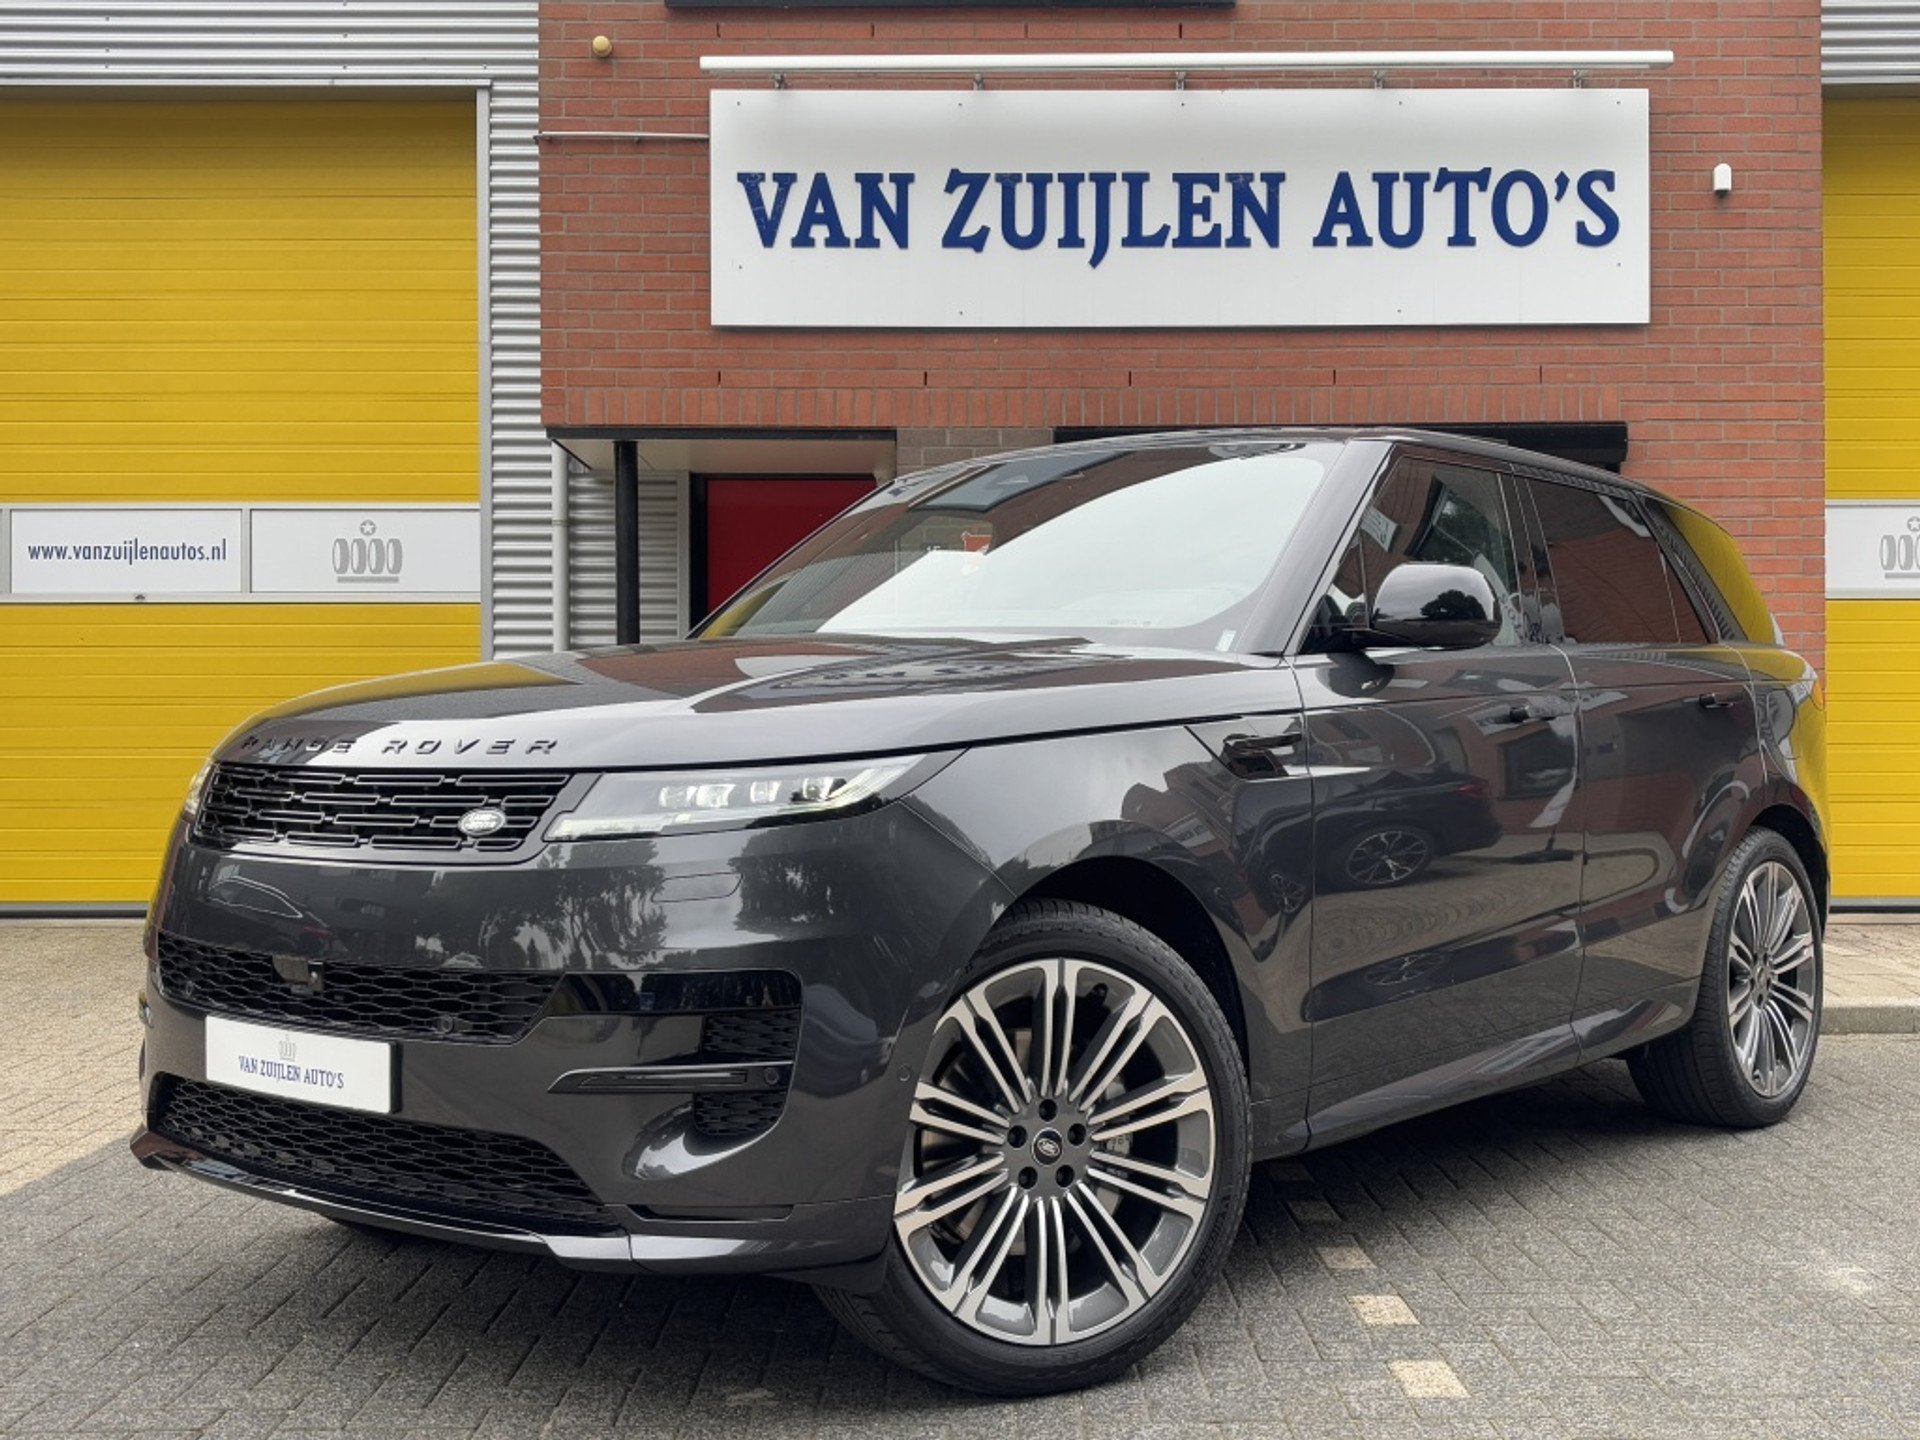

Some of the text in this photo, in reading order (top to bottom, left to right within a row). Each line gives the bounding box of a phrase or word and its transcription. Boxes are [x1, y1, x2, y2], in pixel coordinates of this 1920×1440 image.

[737, 167, 1621, 268] VAN ZUIJLEN AUTO'S
[28, 537, 227, 565] www.vanzuijlenautos.nl
[381, 739, 558, 755] ROVER
[238, 1055, 345, 1090] VAN ZUIJLEN AUTO'S
